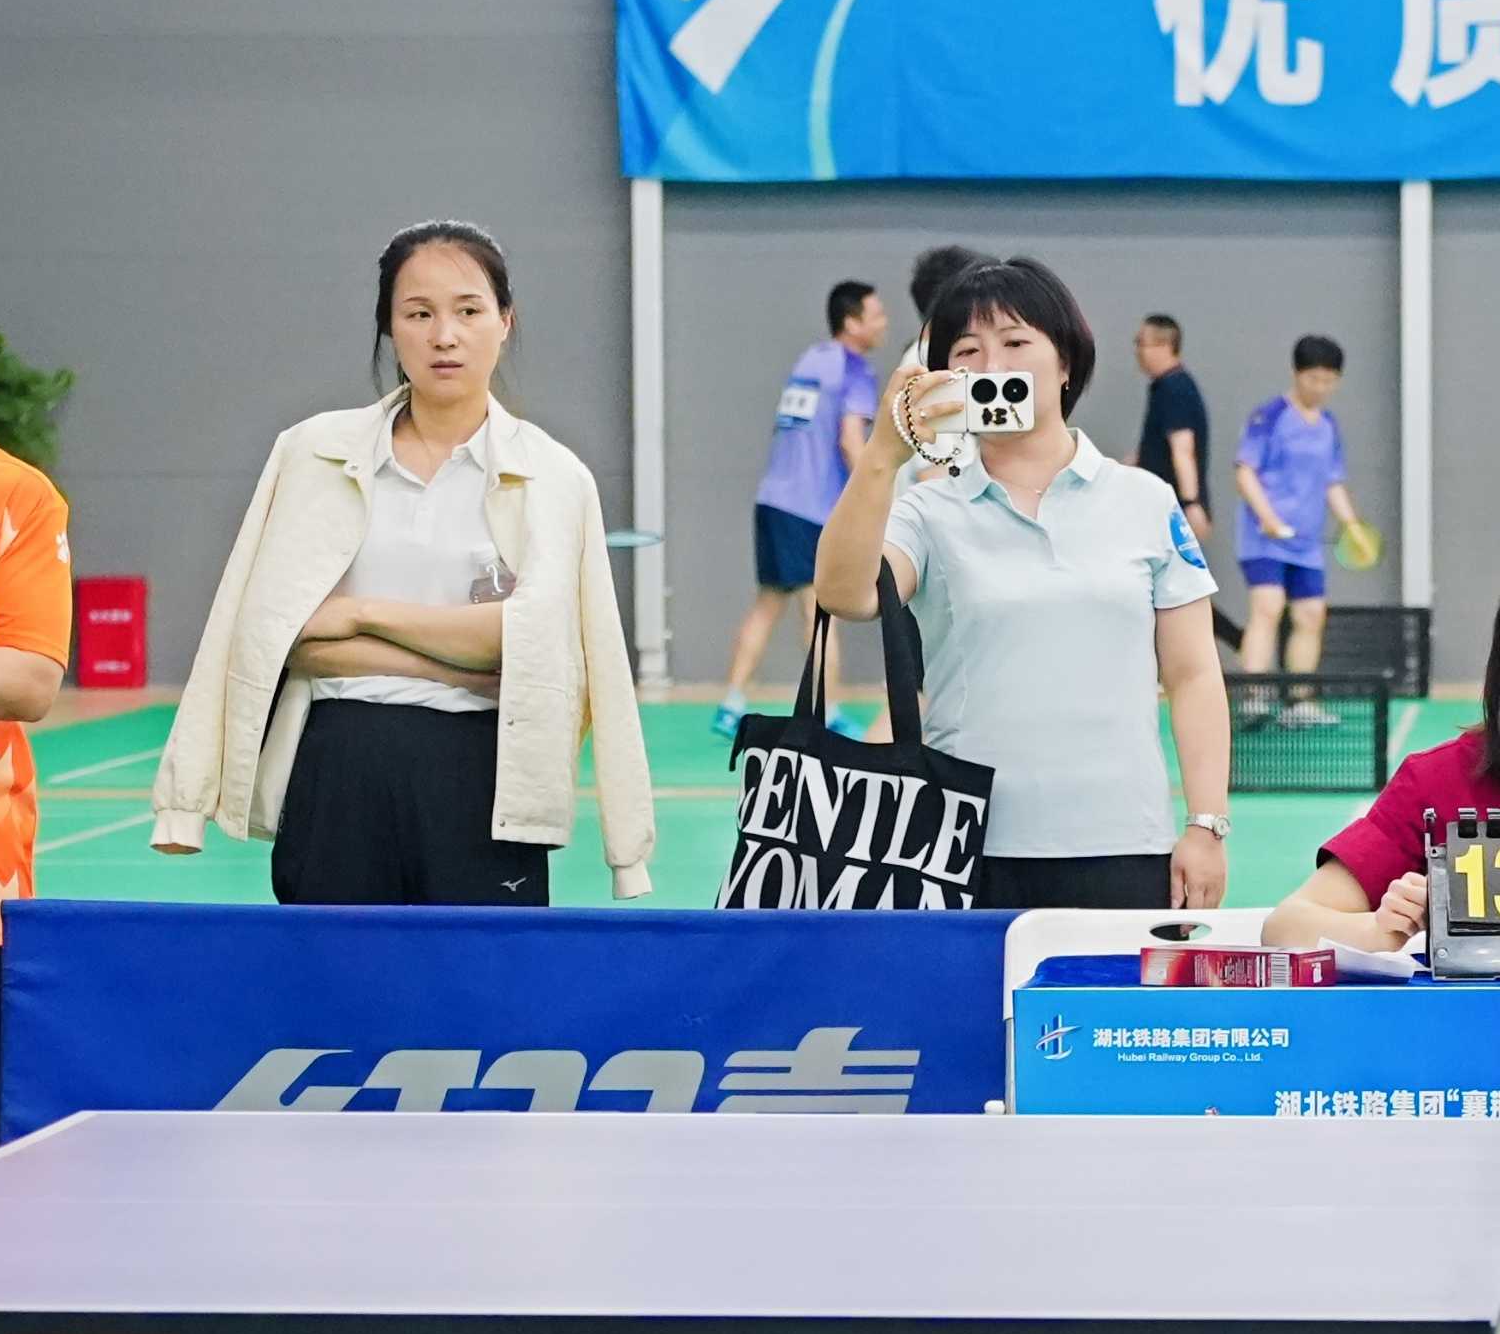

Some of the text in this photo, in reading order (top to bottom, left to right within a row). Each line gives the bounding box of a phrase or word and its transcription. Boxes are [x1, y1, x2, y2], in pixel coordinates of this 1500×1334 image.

[1093, 1028, 1290, 1048] 湖北铁路集团有限公司
[1117, 1052, 1147, 1062] Hubei
[1148, 1052, 1189, 1064] Railway
[1189, 1053, 1221, 1064] Group
[1244, 1053, 1264, 1062] Ltd.
